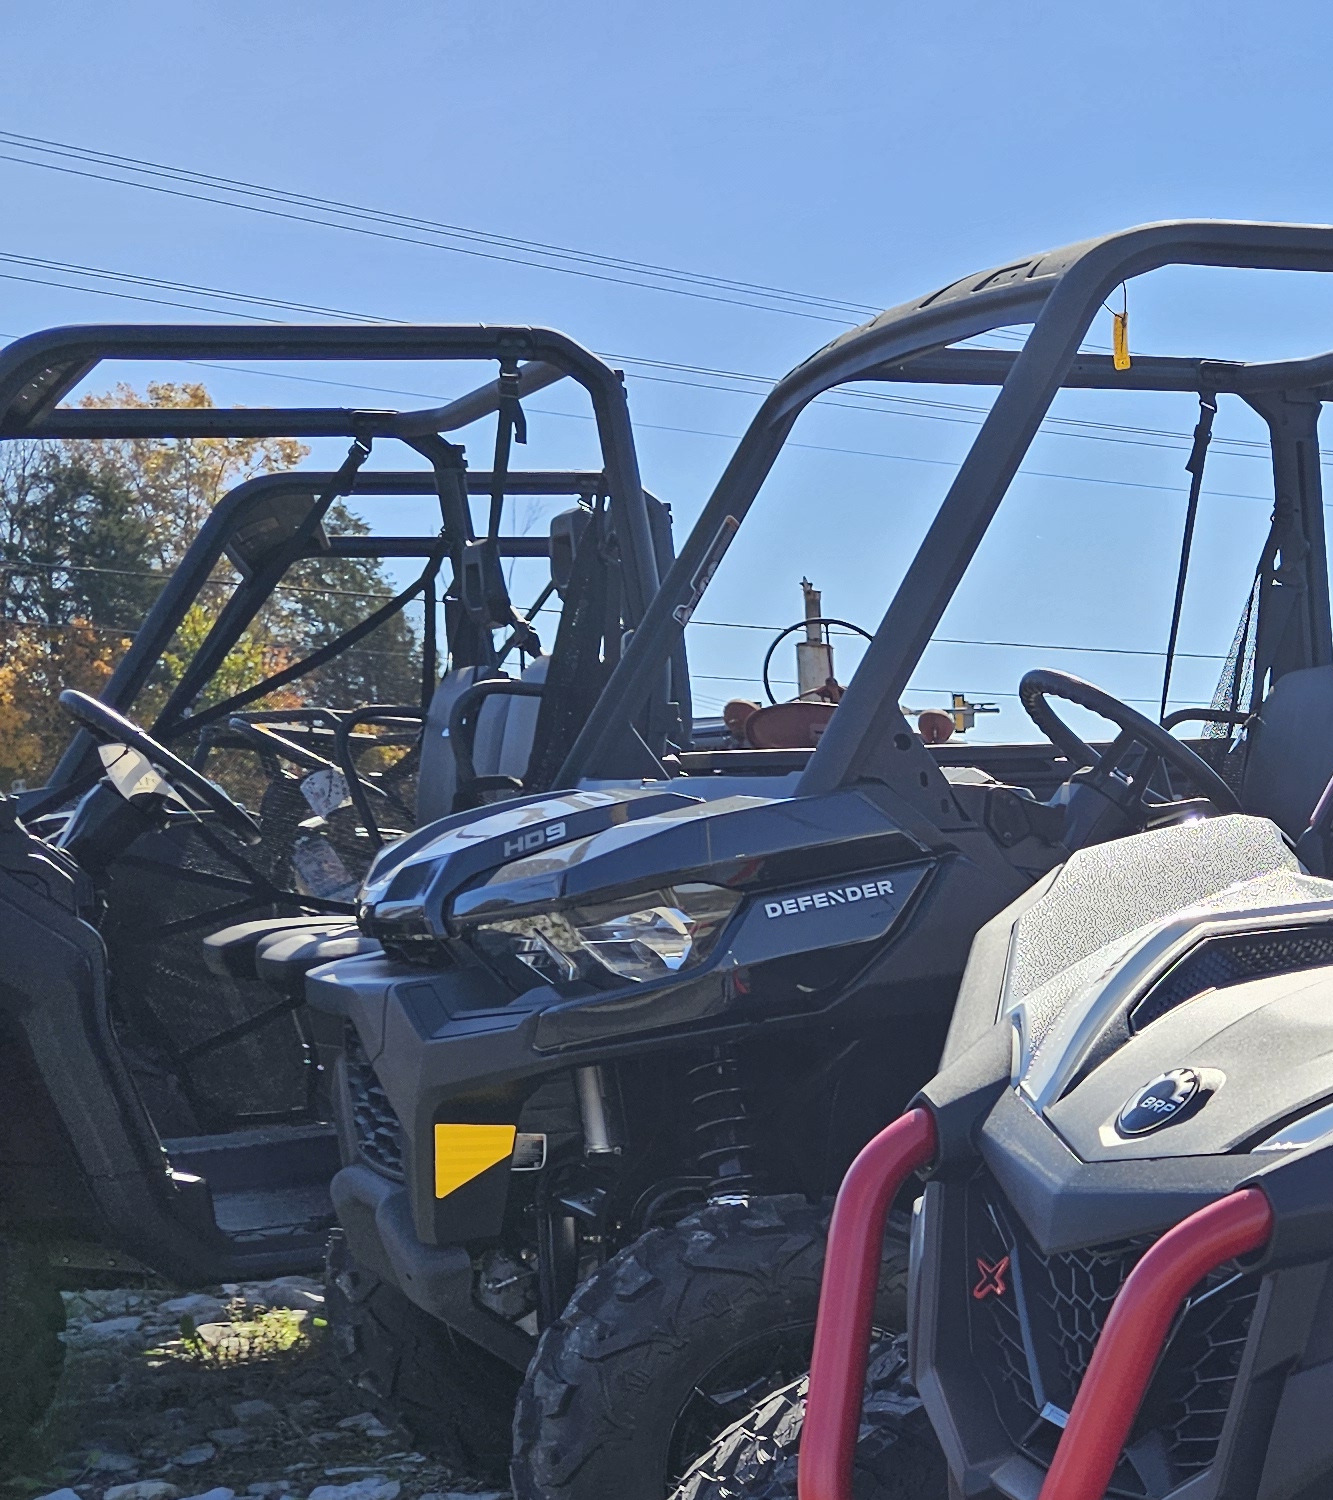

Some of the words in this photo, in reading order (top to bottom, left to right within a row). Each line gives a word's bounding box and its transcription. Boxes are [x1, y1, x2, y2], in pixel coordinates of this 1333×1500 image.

[503, 821, 566, 857] HD9
[764, 879, 894, 919] DEFENDER
[1139, 1095, 1177, 1114] BRP
